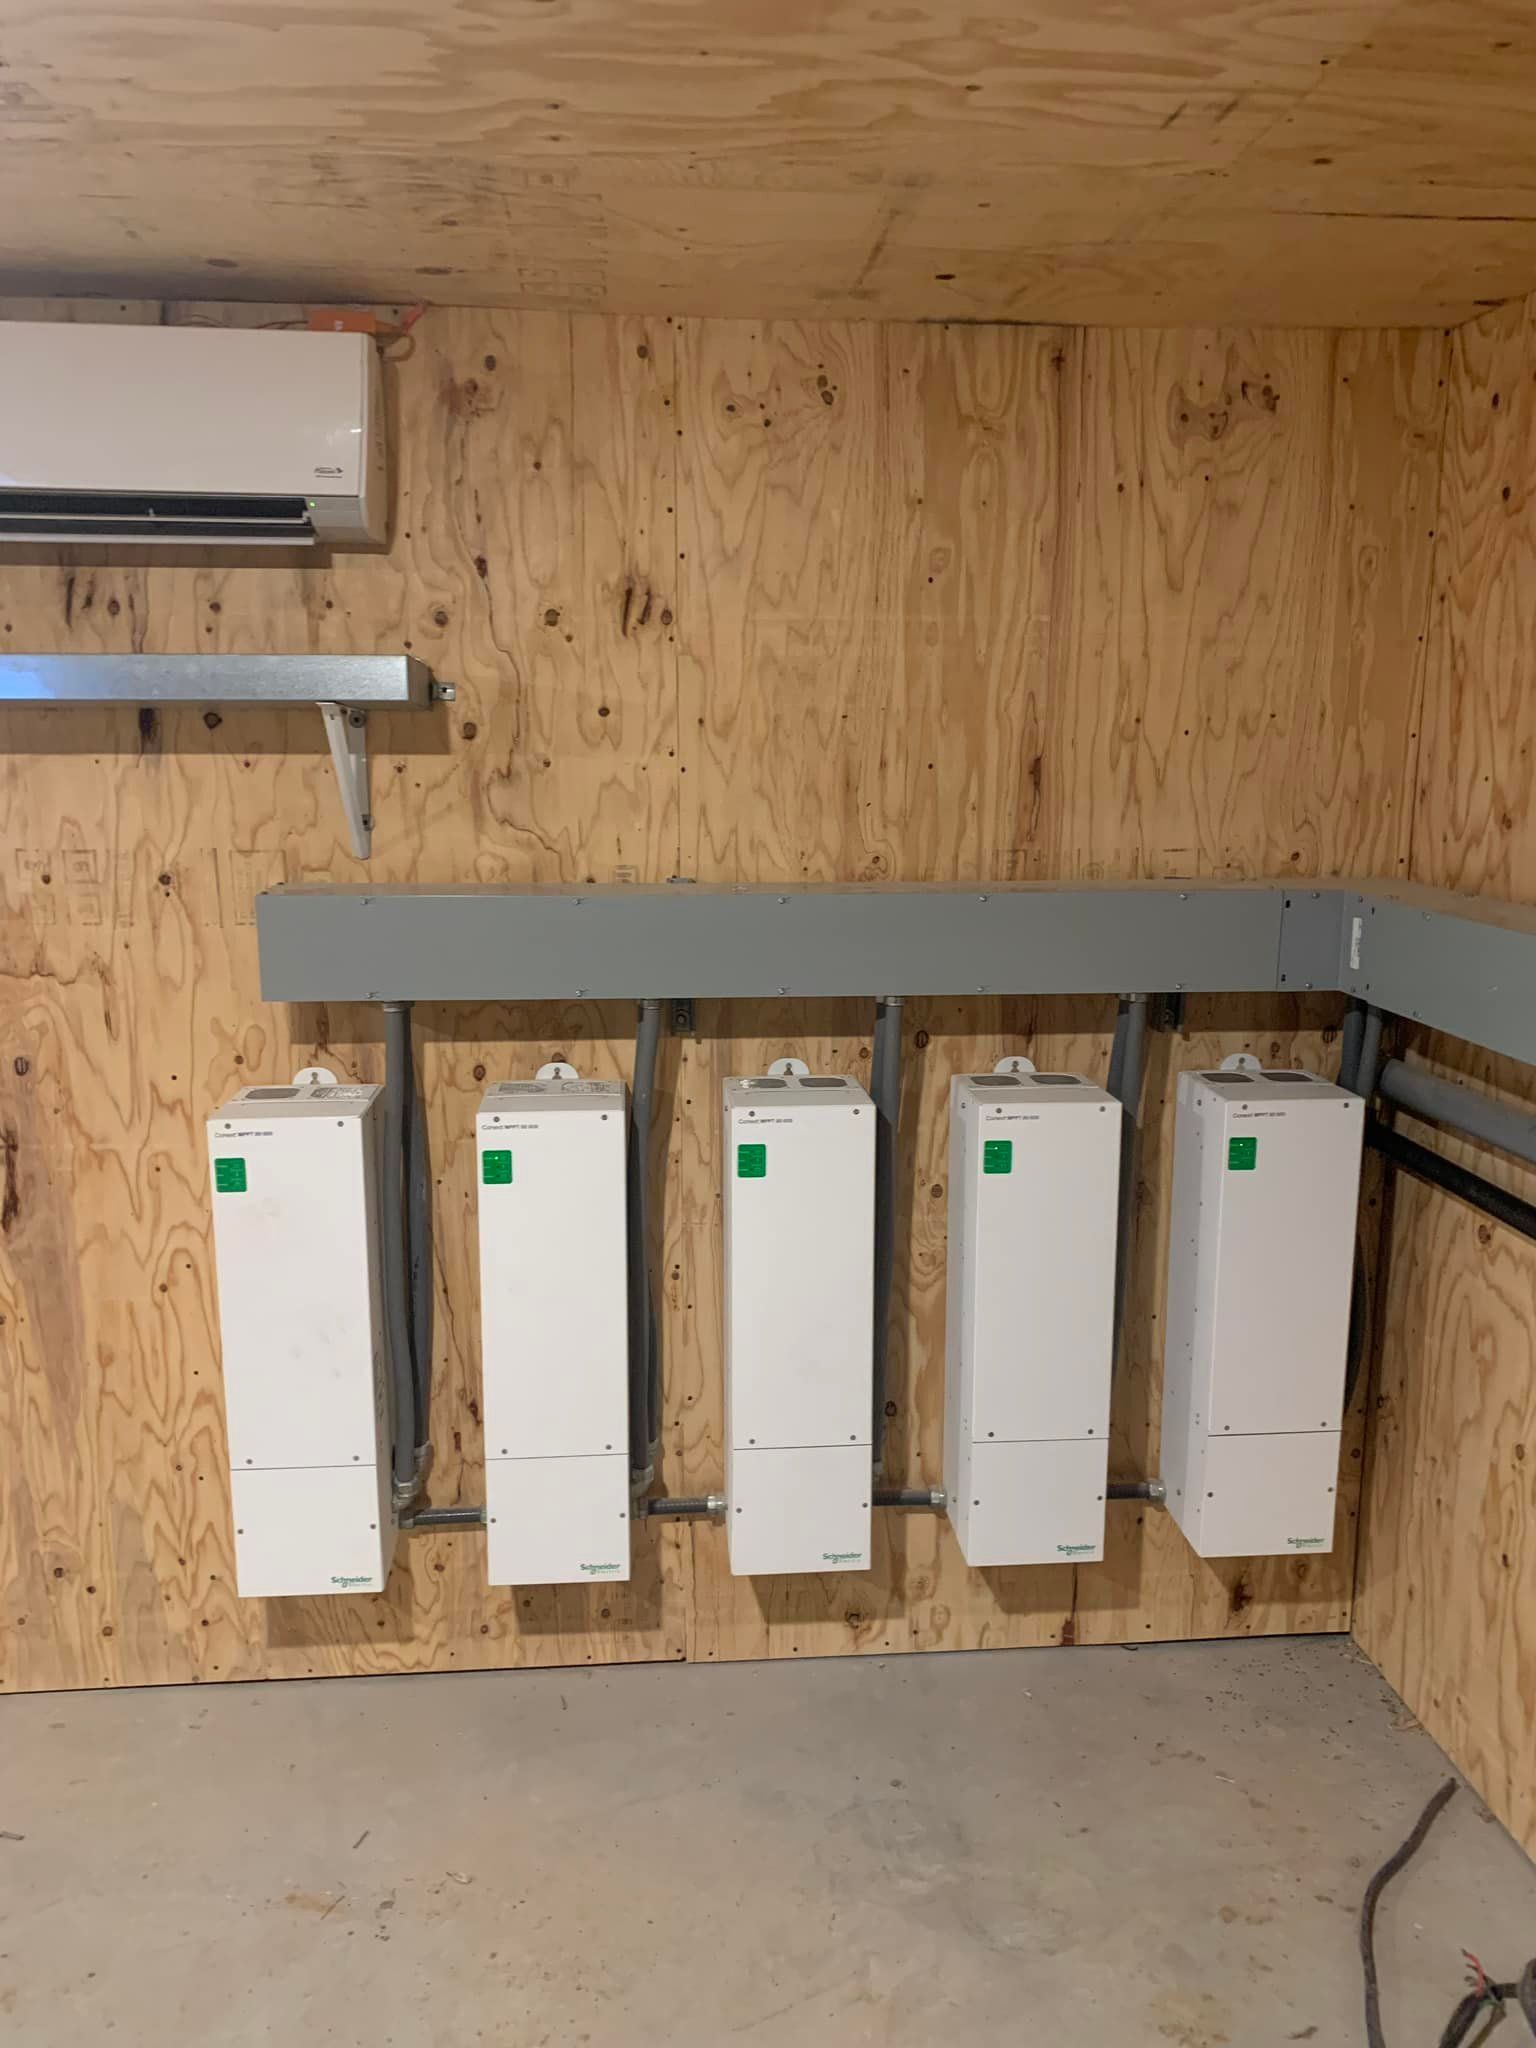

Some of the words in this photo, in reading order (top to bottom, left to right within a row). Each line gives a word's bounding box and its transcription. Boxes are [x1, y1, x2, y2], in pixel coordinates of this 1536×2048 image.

[1287, 1536, 1325, 1549] Schneider
[1056, 1543, 1096, 1557] Schneider
[822, 1551, 863, 1565] Schneider
[580, 1562, 621, 1576] Schneider
[330, 1575, 373, 1589] Schneider
